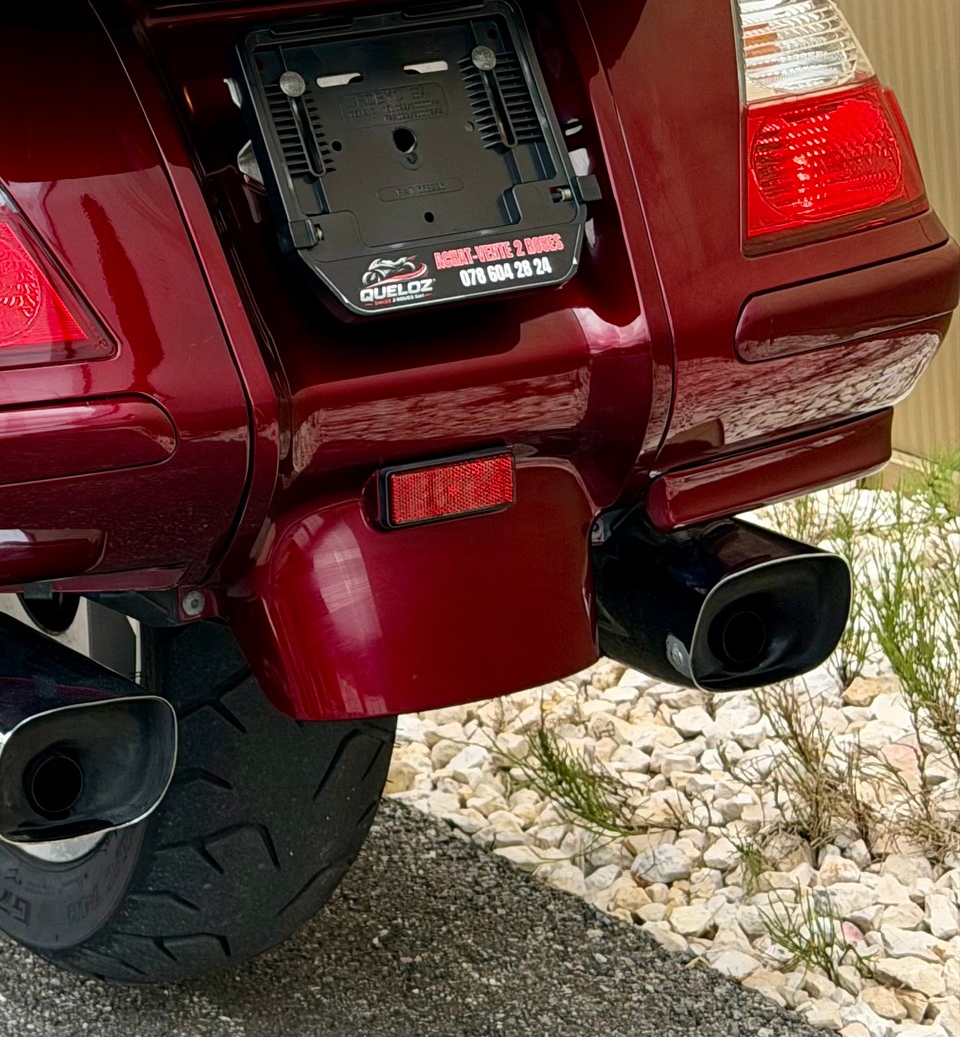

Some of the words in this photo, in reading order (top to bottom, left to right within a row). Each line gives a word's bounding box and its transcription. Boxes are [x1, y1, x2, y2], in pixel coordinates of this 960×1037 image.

[513, 240, 525, 257] 2
[459, 266, 487, 287] 078
[486, 263, 515, 284] 604
[514, 260, 534, 279] 28
[533, 256, 553, 275] 24
[359, 279, 433, 303] QUELOZ
